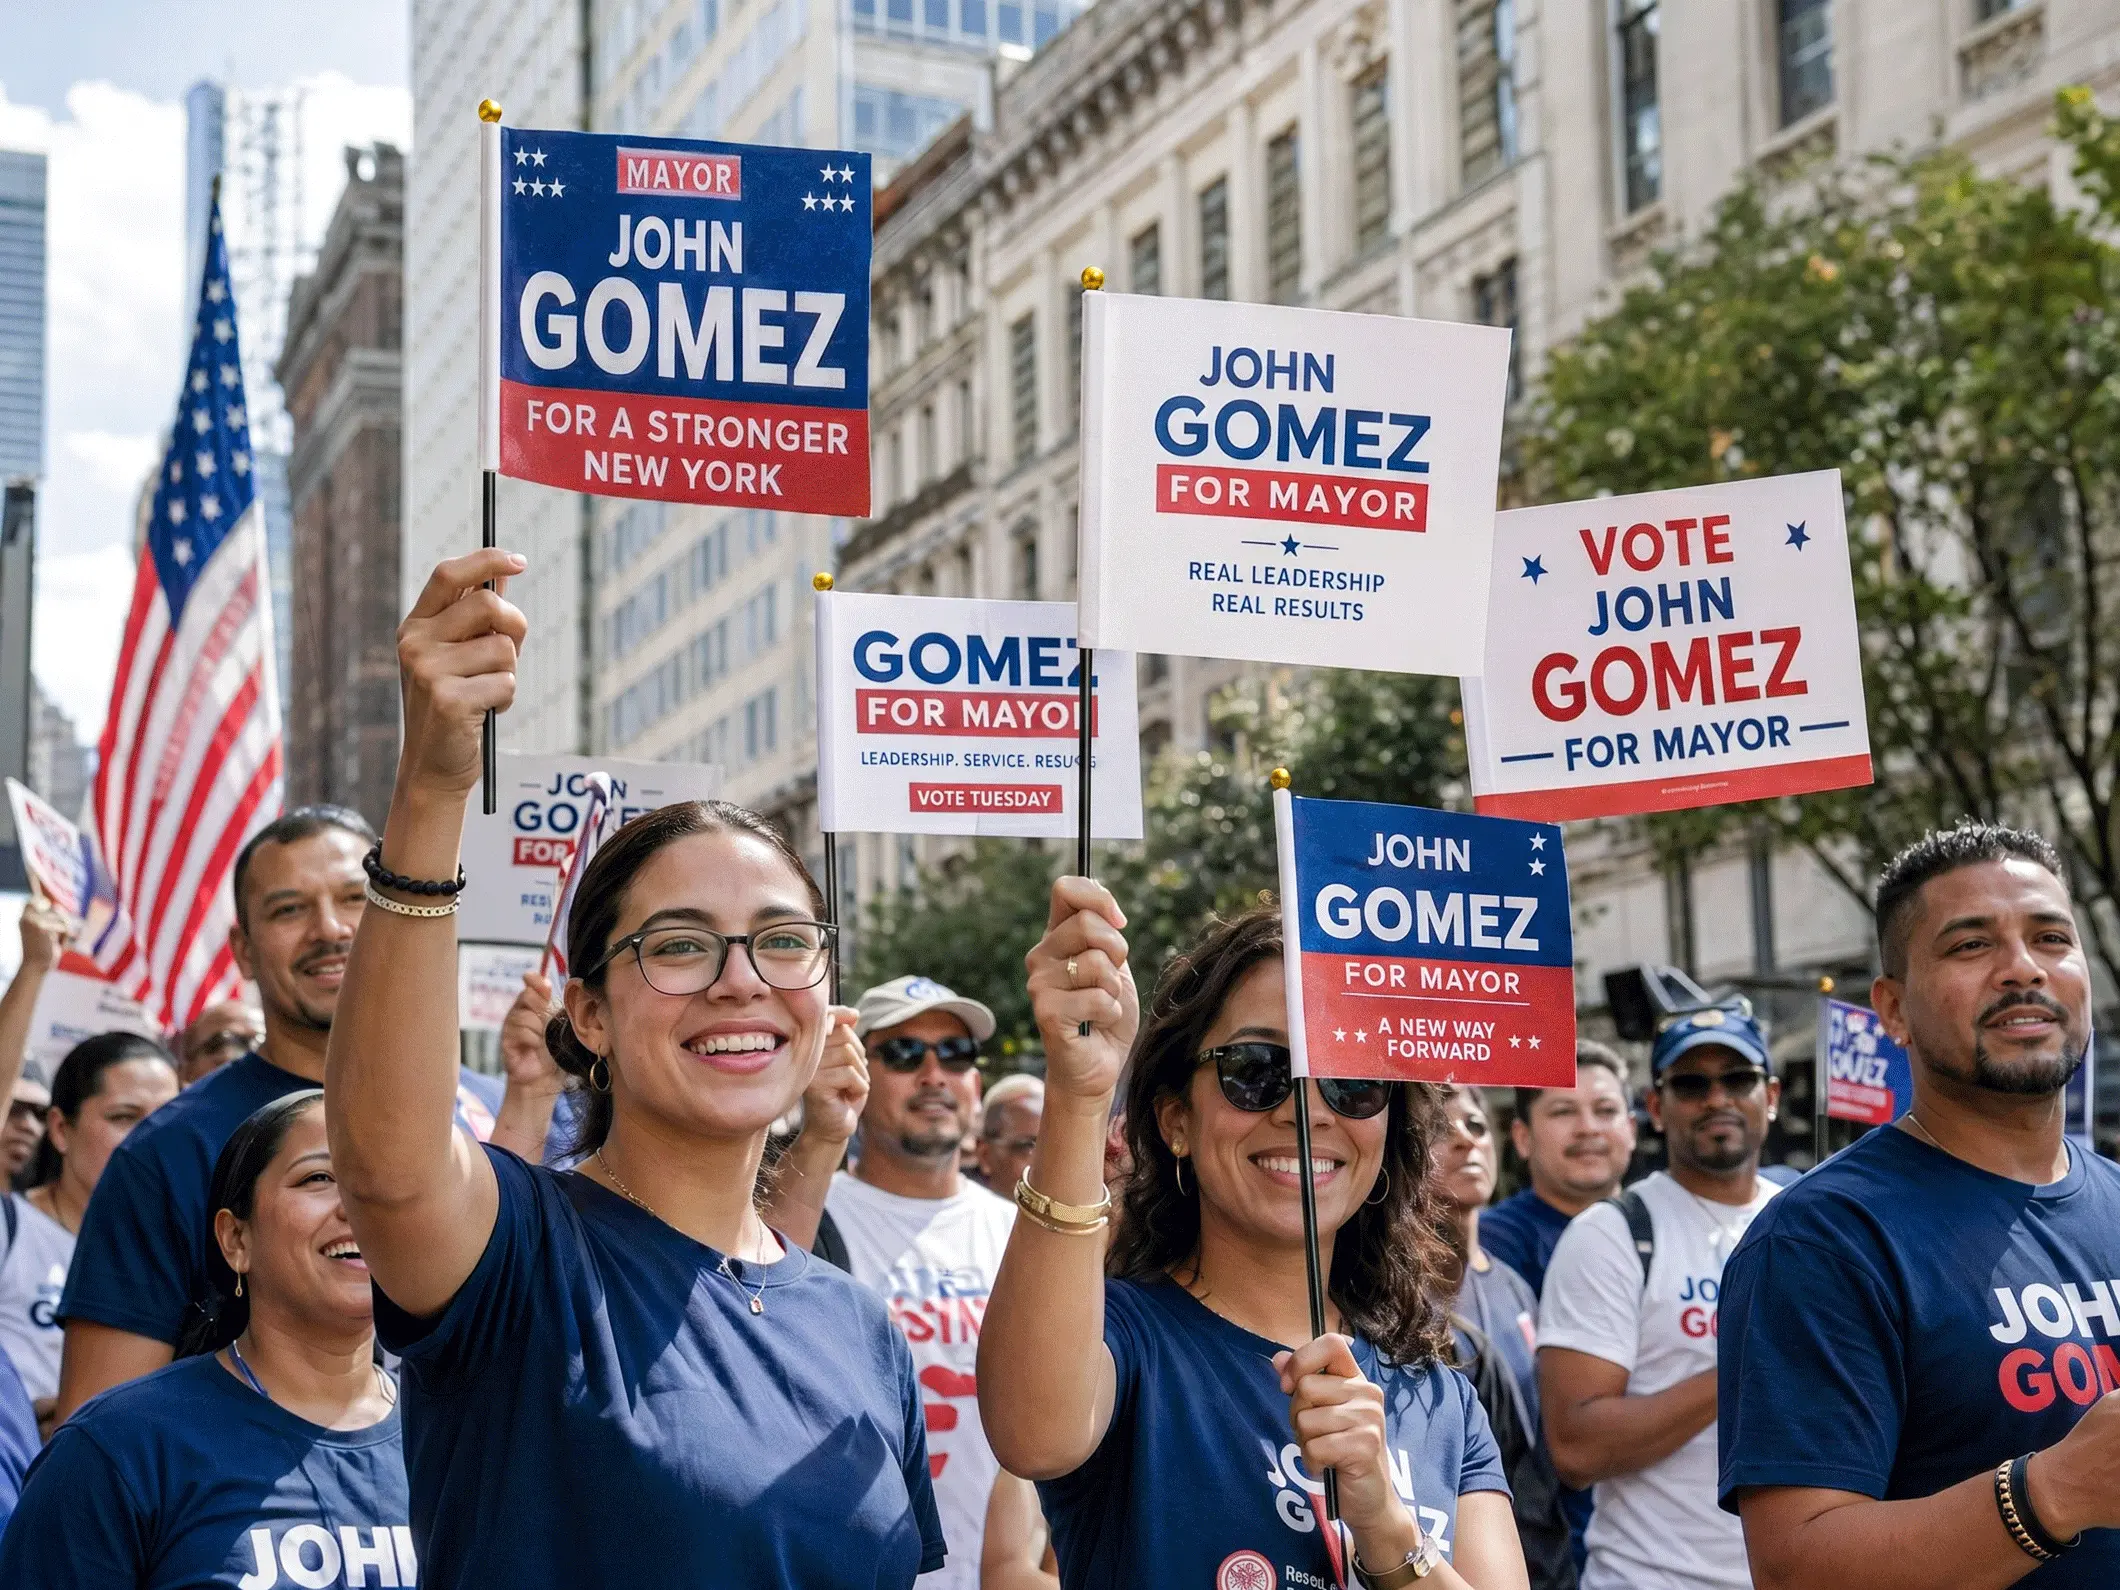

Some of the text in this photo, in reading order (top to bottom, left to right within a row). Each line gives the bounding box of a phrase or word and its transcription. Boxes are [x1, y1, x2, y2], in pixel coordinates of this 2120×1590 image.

[627, 158, 732, 193] MAYOR
[608, 214, 743, 273] JOHN
[519, 270, 846, 389] GOMEZ
[1199, 346, 1334, 393] JOHN
[527, 400, 848, 455] FOR A STRONGER
[1154, 395, 1431, 473] GOMEZ
[584, 450, 783, 496] NEW YORK
[1170, 474, 1416, 521] FOR MAYOR
[1579, 514, 1734, 576] VOTE
[1189, 562, 1385, 593] REAL LEADERSHIP
[1212, 594, 1363, 621] REAL RESULTS
[1587, 576, 1735, 636] JOHN
[1532, 626, 1809, 723] GOMEZ
[867, 697, 946, 728] FOR
[861, 751, 958, 767] LEADERSHIP.
[964, 754, 1030, 768] SERVICE.
[1564, 715, 1791, 772] FOR MAYOR
[547, 773, 627, 799] JON
[917, 790, 1051, 808] VOTE TUESDAY
[1367, 833, 1471, 872] JOHN
[1315, 883, 1539, 951] GOMEZ
[1345, 962, 1520, 995] FOR MAYOR
[1378, 1017, 1496, 1040] A NEW WAY
[1387, 1039, 1491, 1061] FORWARD
[1680, 1276, 1720, 1301] JO
[1989, 1279, 2120, 1344] JOH
[1260, 1439, 1415, 1500] JON
